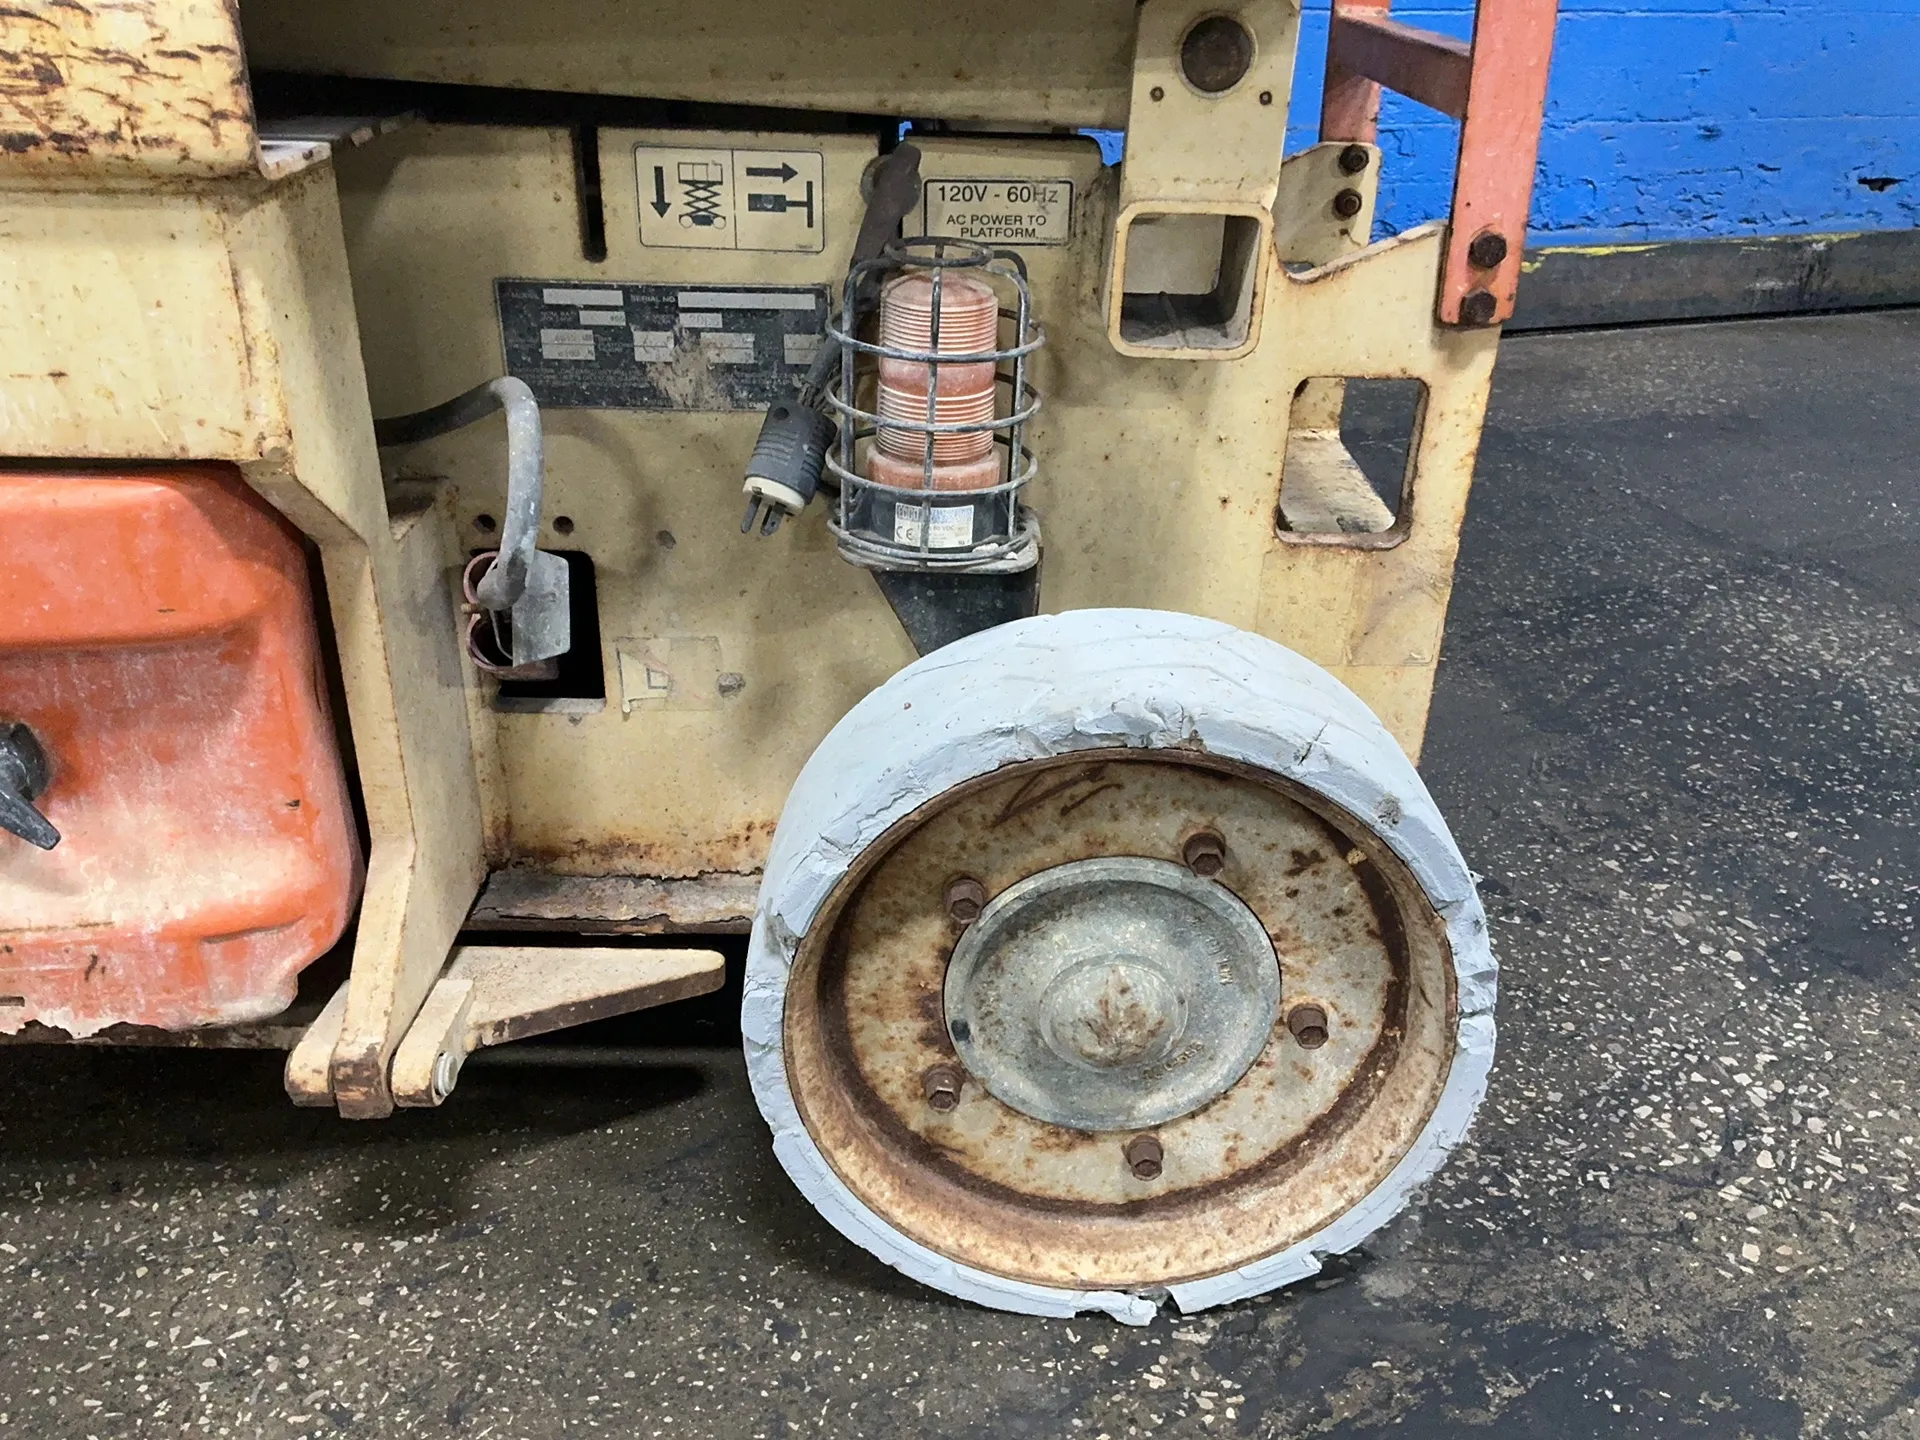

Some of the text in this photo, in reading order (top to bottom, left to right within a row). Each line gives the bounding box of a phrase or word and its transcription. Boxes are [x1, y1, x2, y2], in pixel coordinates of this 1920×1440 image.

[938, 185, 988, 202] 120V
[946, 214, 1047, 226] AC POWER TO
[960, 227, 1037, 239] PLATFORM
